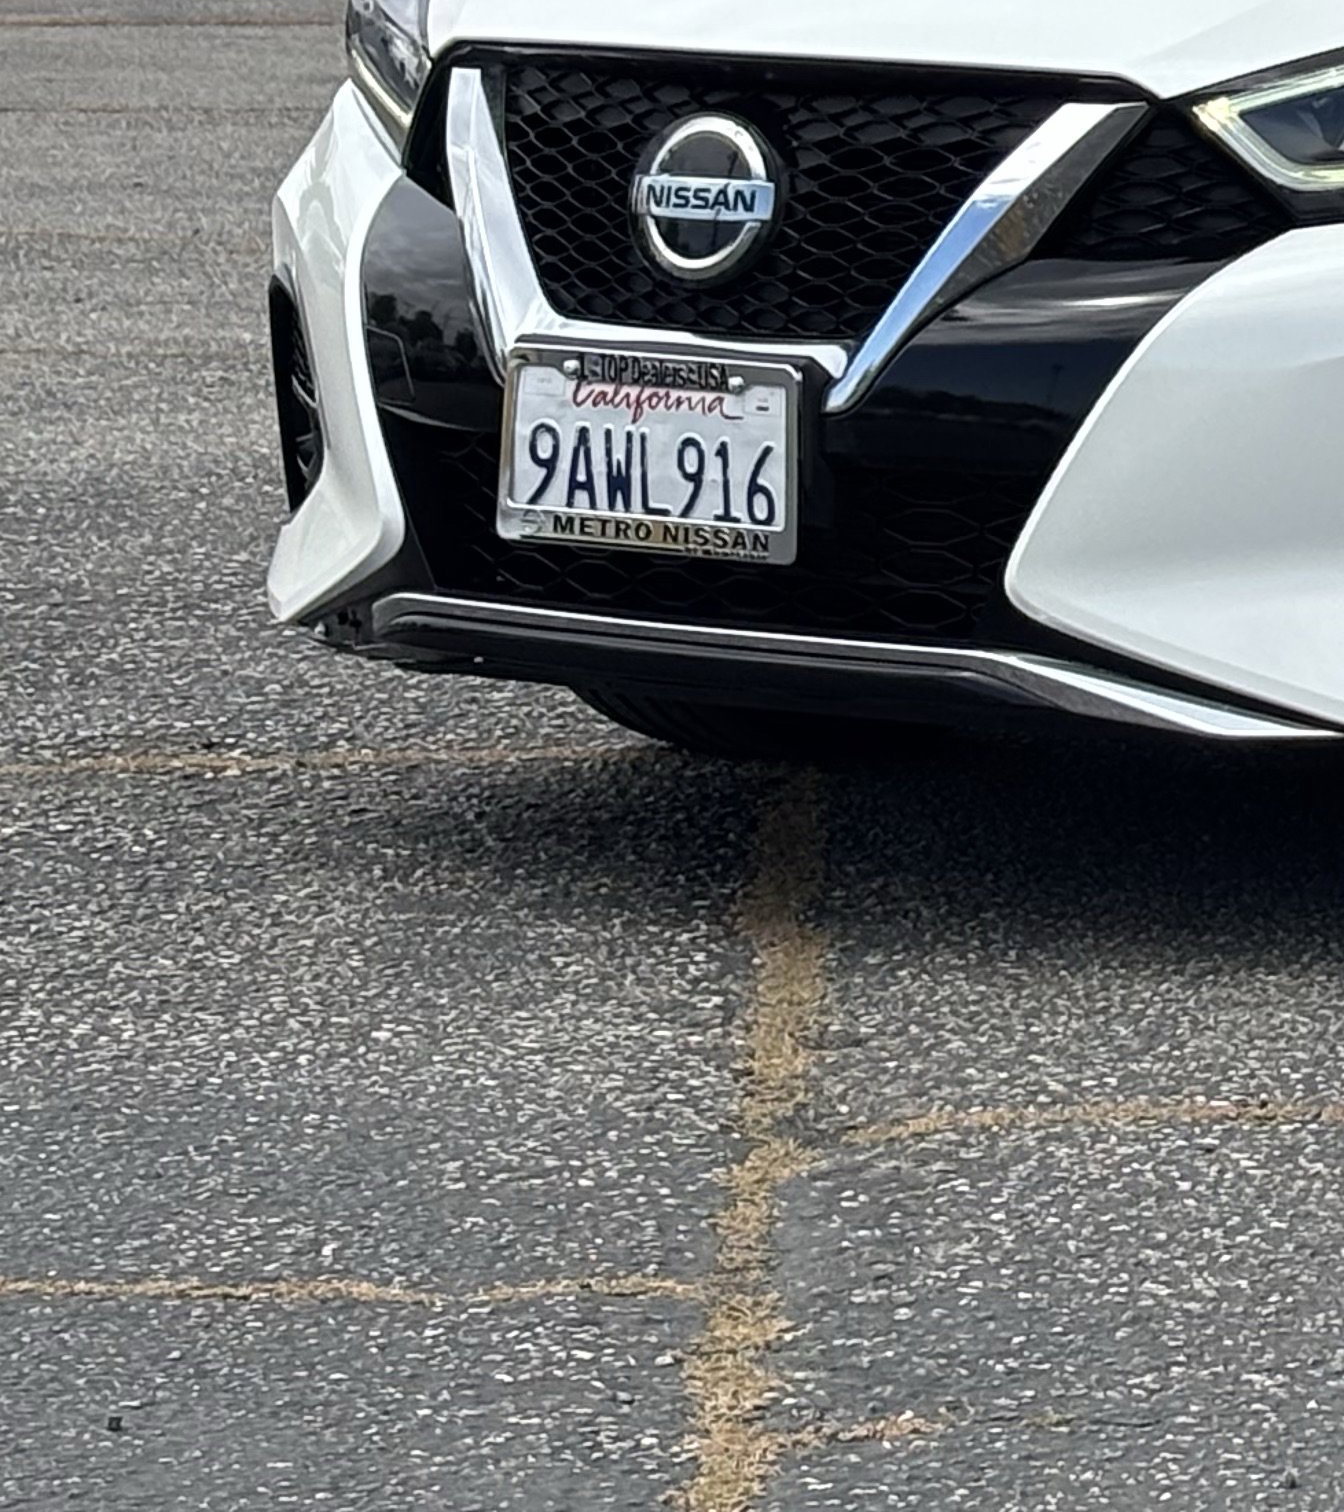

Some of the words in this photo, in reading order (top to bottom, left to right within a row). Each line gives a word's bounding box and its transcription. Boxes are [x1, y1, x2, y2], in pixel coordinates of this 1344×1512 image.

[646, 184, 757, 212] NISSAN
[572, 380, 744, 424] California
[527, 422, 776, 526] 9AWL916
[553, 514, 651, 540] METRO
[662, 523, 770, 552] NISSAN
